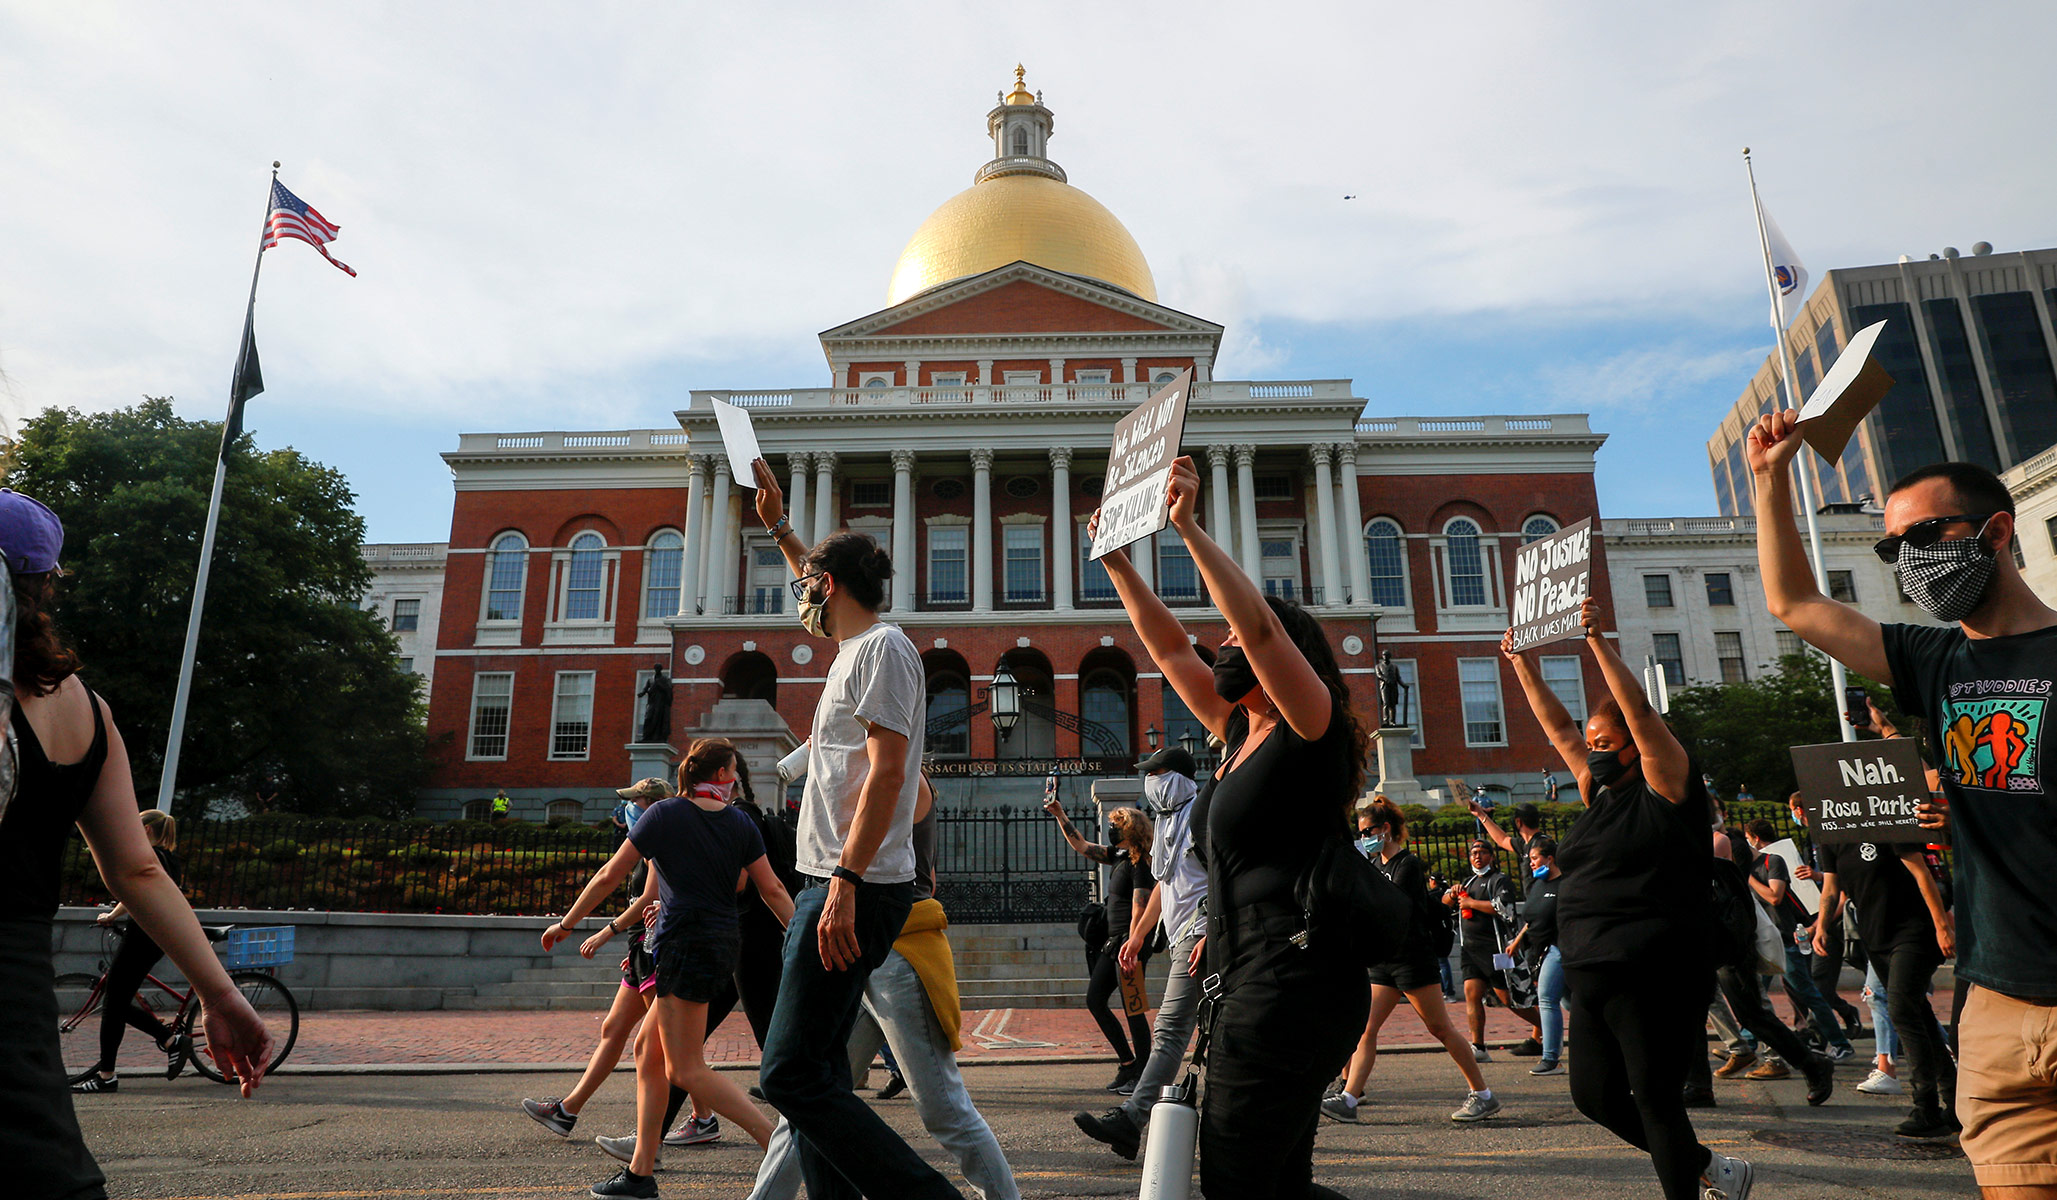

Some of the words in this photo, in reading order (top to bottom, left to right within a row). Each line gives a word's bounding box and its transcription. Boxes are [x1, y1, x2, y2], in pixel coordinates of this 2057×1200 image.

[1154, 391, 1180, 433] NOT
[1099, 503, 1123, 539] STOP
[1123, 482, 1158, 521] KILLING
[1516, 547, 1539, 586] NO
[1513, 583, 1536, 627] NO
[1513, 625, 1539, 650] BLACK
[1541, 619, 1560, 638] LIVES
[1059, 760, 1102, 772] HOUSE
[1838, 756, 1905, 788] Nah.
[1821, 798, 1862, 819] Rosa
[1867, 793, 1921, 816] Parks
